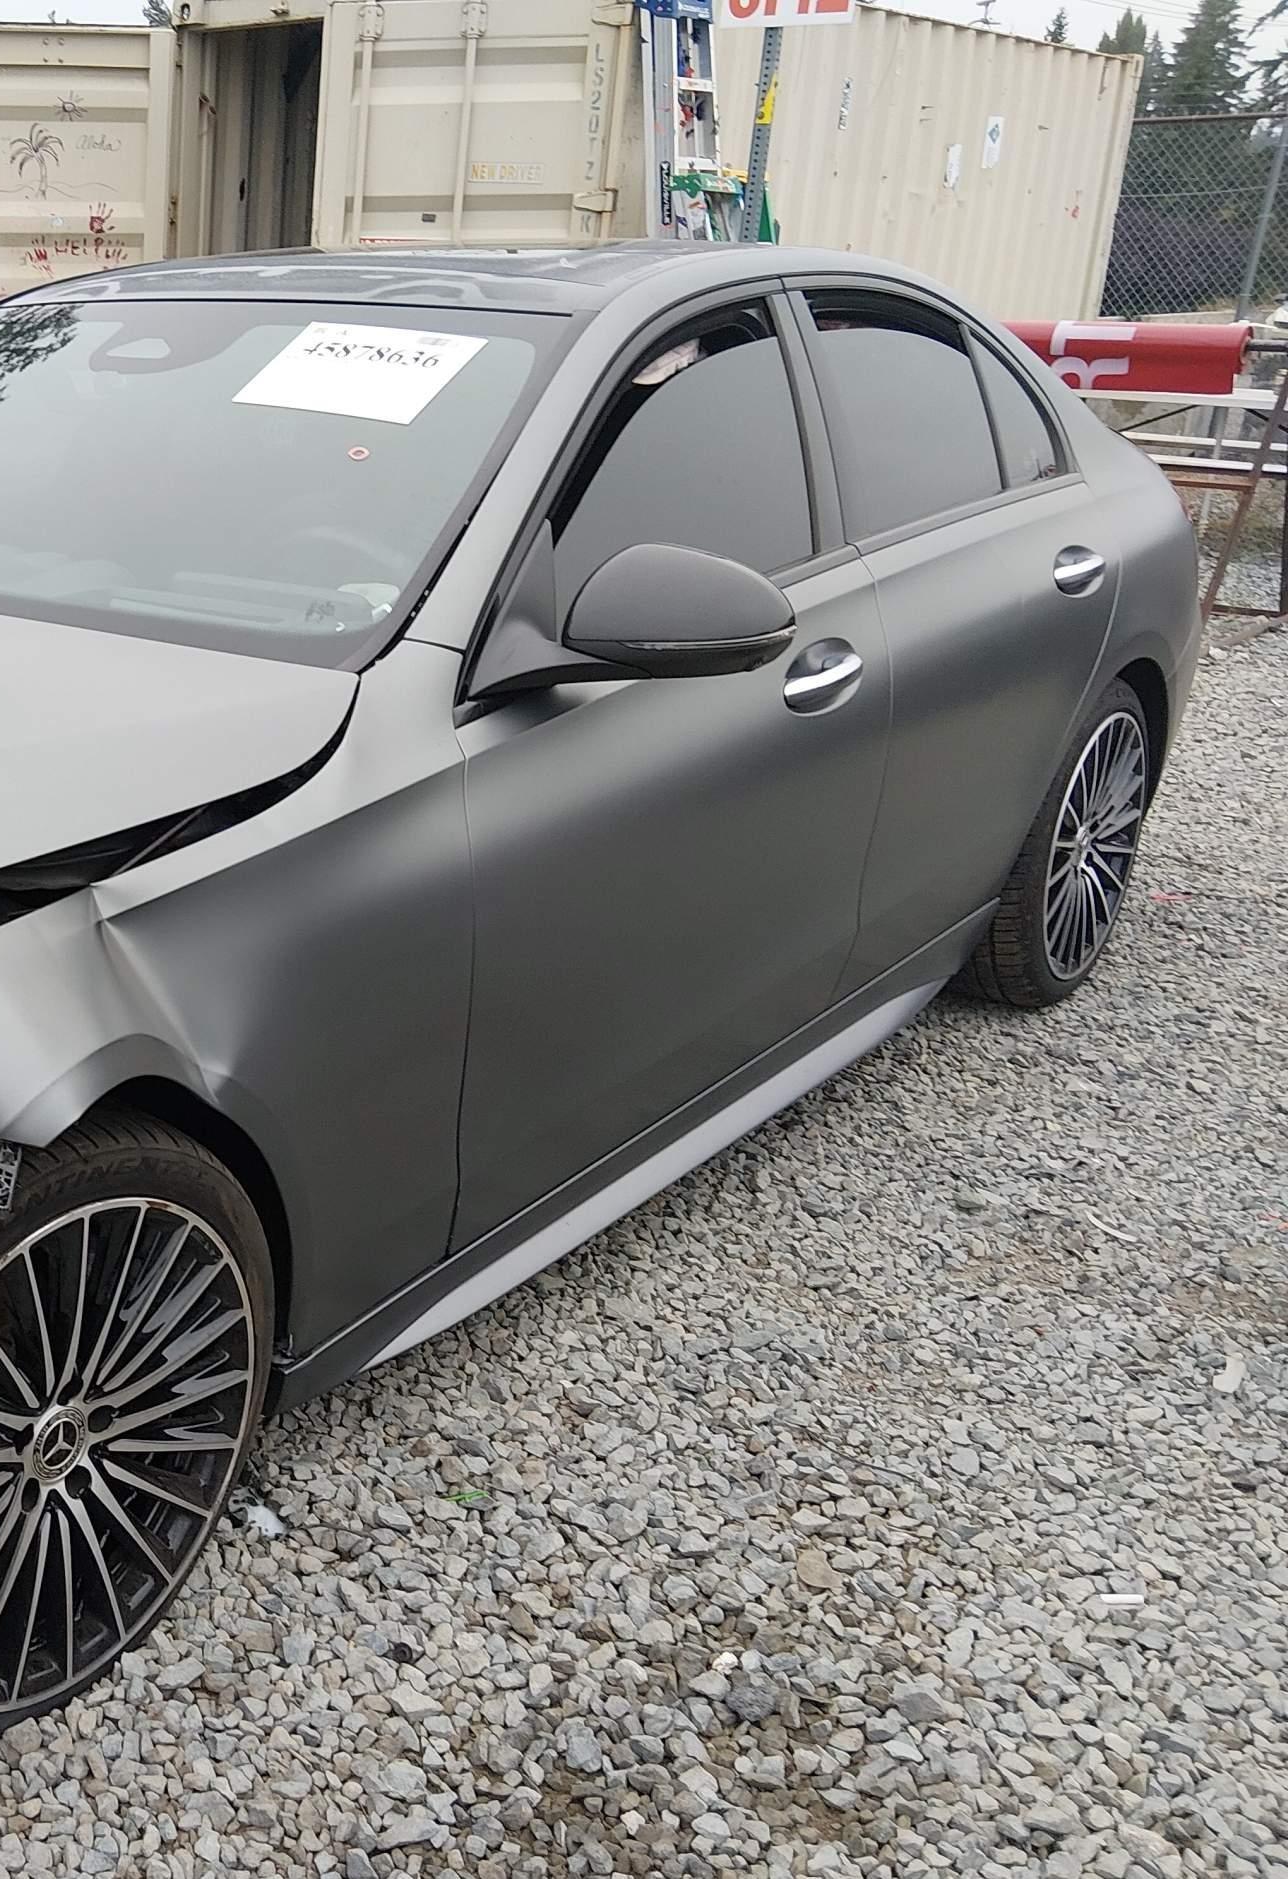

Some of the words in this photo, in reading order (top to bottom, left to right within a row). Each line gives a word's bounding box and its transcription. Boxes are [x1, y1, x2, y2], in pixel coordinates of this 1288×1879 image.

[470, 163, 496, 180] NEW
[499, 164, 543, 181] DRIVER
[303, 341, 441, 368] 45878636
